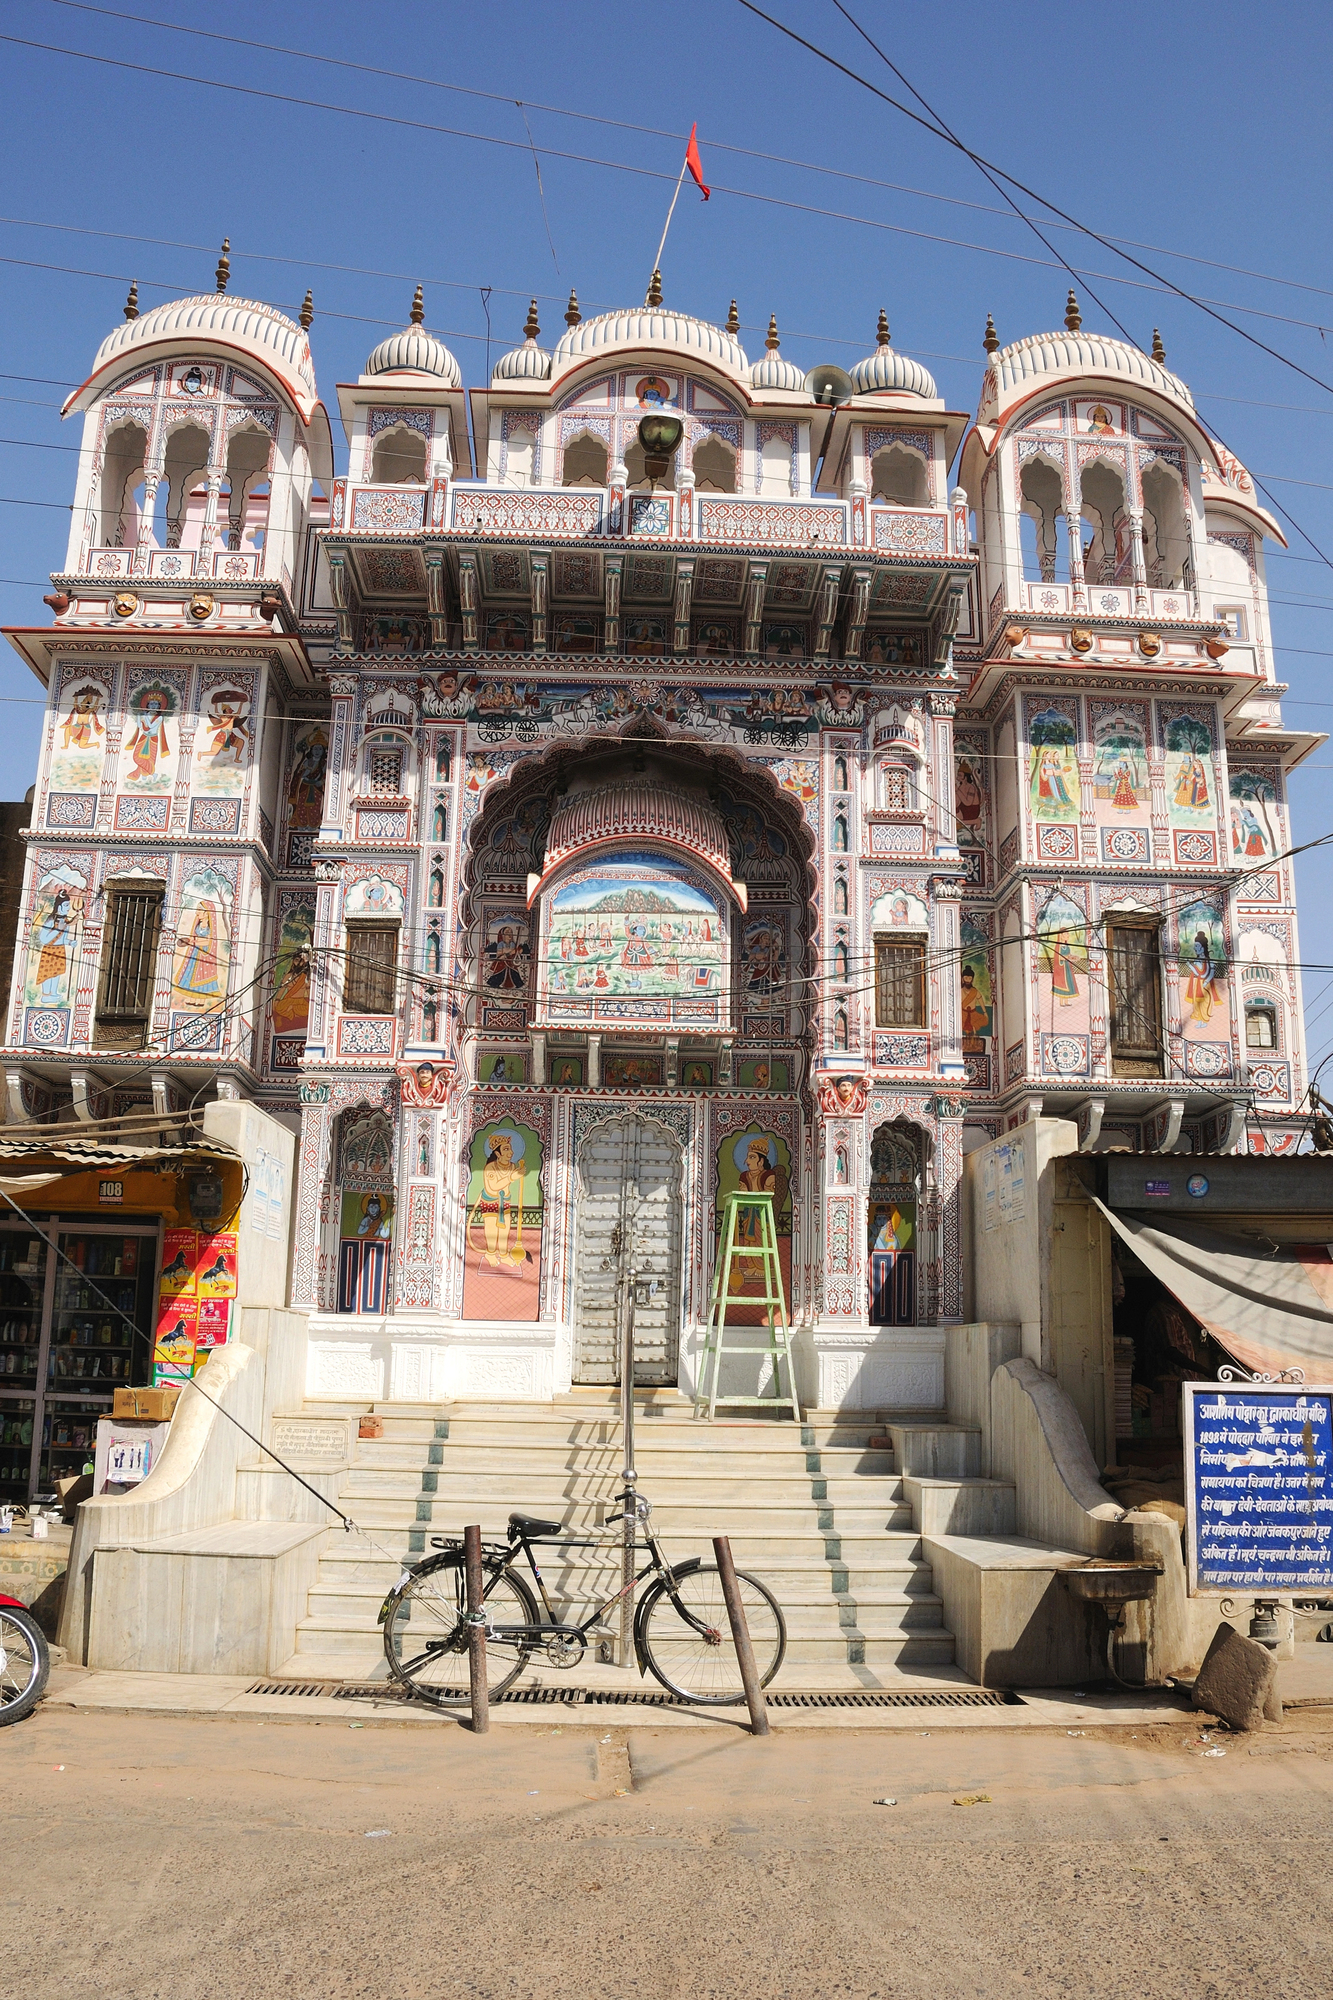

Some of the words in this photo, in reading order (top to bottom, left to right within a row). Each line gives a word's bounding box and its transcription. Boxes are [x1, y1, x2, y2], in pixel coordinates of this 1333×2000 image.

[101, 1182, 123, 1197] 108
[1308, 1402, 1327, 1424] मंदिर
[1200, 1431, 1219, 1444] 1898
[1220, 1427, 1228, 1444] में
[1281, 1428, 1289, 1445] ने
[1316, 1450, 1326, 1467] में
[1201, 1476, 1235, 1489] रामायण
[1235, 1477, 1248, 1489] का
[1248, 1472, 1274, 1489] चित्रण
[1201, 1495, 1213, 1511] की
[1287, 1495, 1296, 1512] के
[1202, 1520, 1211, 1537] से
[1211, 1520, 1240, 1538] पश्चिम
[1239, 1521, 1252, 1538] की
[1251, 1521, 1267, 1538] ओर
[1267, 1525, 1301, 1541] जनकपुर
[1317, 1525, 1332, 1543] हुए
[1202, 1543, 1228, 1560] अंकित
[1285, 1545, 1296, 1561] भी
[1296, 1545, 1319, 1561] अंकित
[1232, 1572, 1245, 1583] पर
[1245, 1567, 1264, 1584] हाथी
[1264, 1572, 1276, 1584] पर
